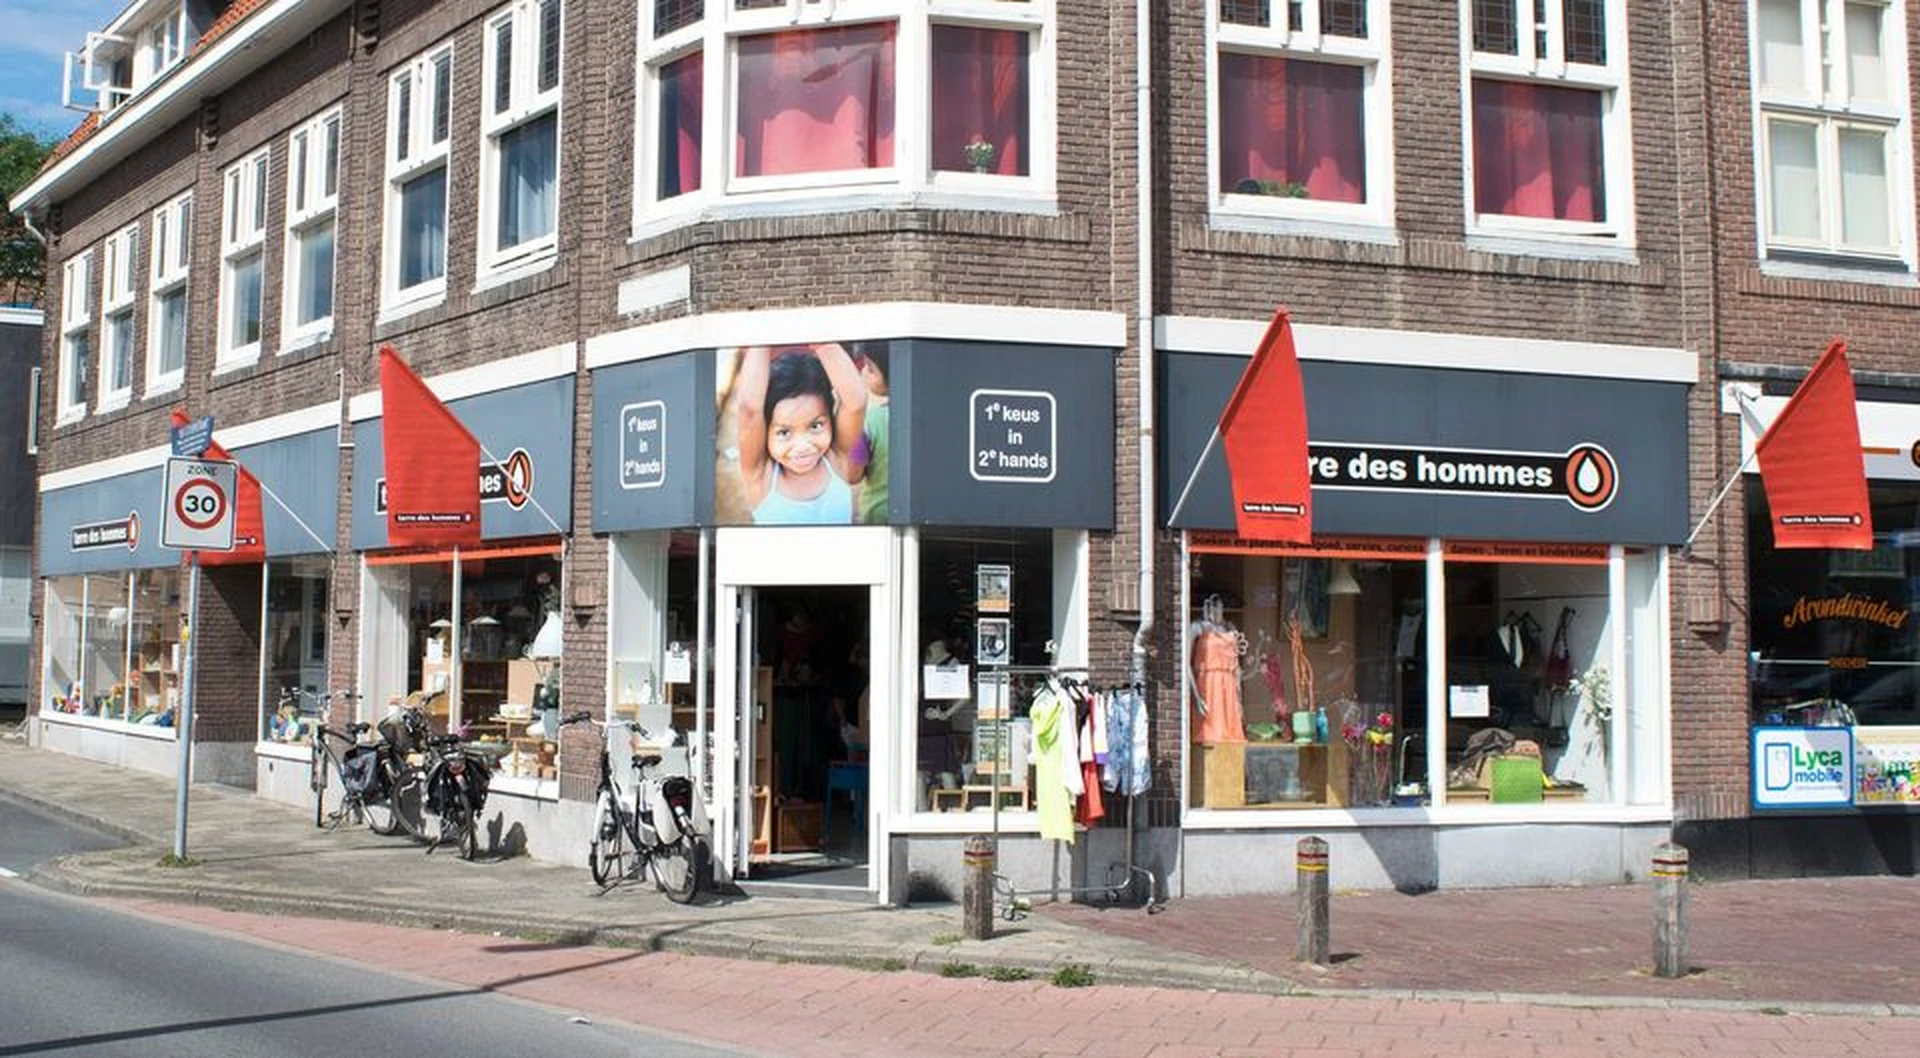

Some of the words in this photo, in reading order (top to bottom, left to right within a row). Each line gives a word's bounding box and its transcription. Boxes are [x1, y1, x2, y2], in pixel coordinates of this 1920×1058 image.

[1003, 405, 1040, 422] keus
[1007, 428, 1023, 444] in
[999, 451, 1048, 469] hands
[187, 464, 217, 476] ZONE
[1348, 452, 1407, 480] des
[1417, 454, 1553, 487] hommes
[185, 495, 216, 513] 30
[1794, 746, 1843, 770] Lyca
[1794, 767, 1843, 783] mobile
